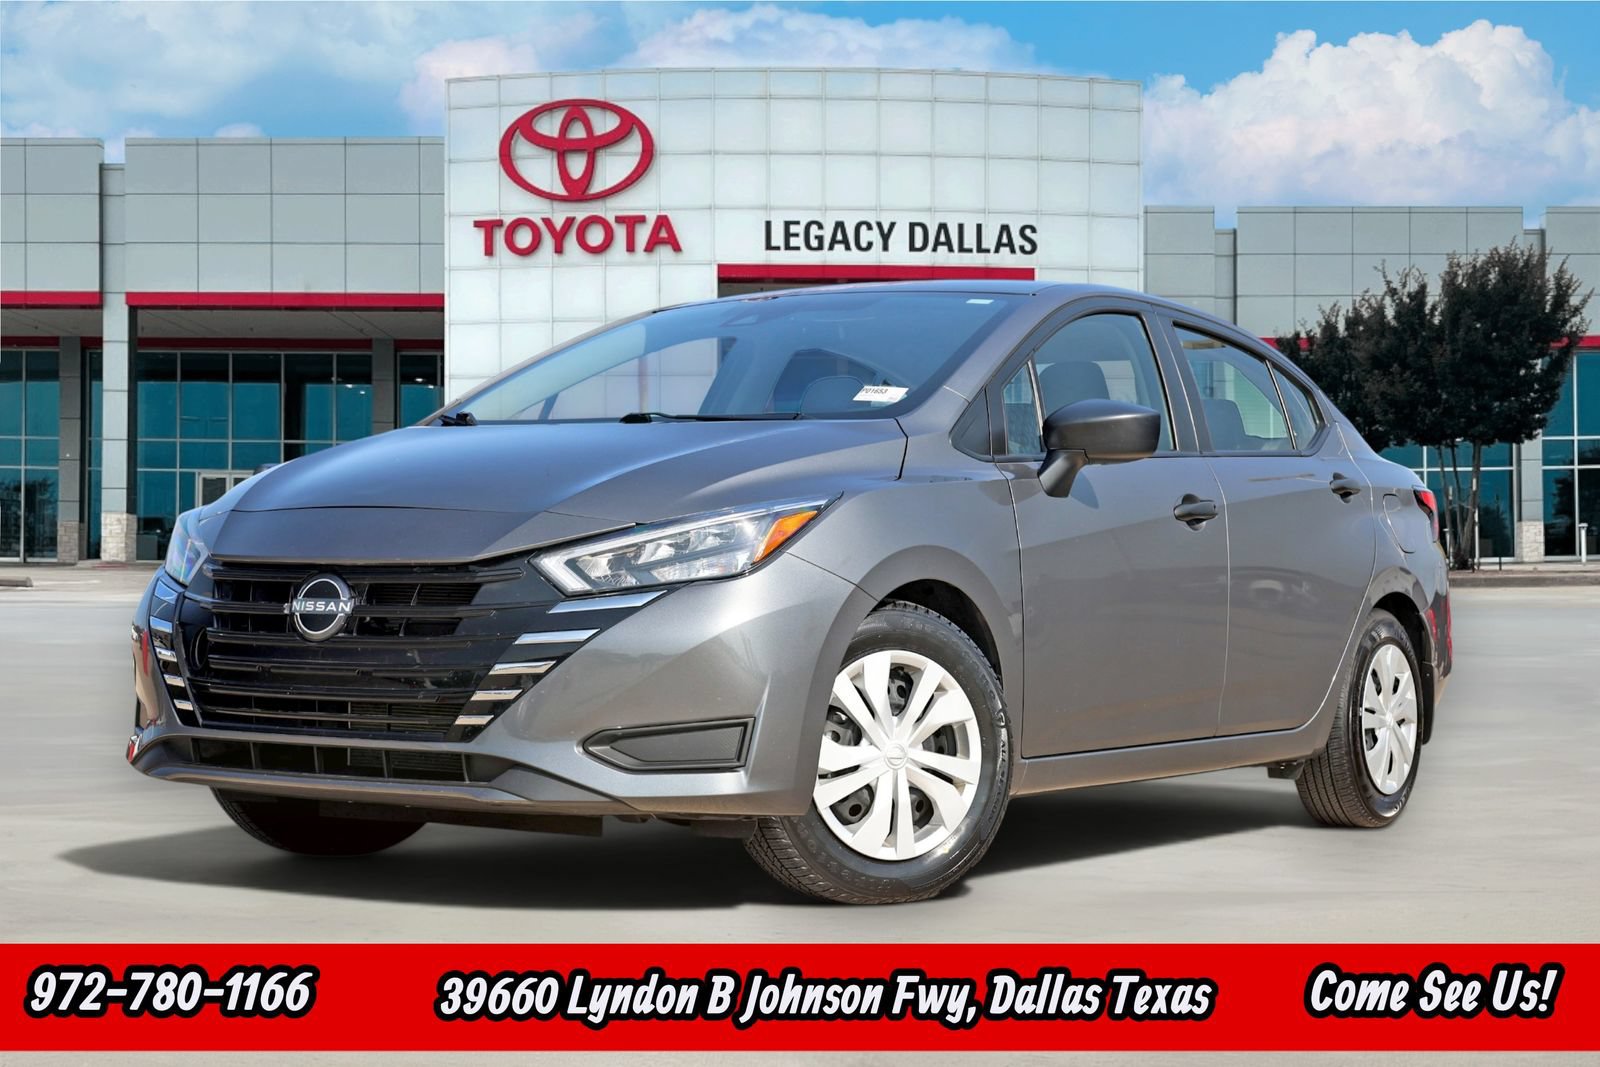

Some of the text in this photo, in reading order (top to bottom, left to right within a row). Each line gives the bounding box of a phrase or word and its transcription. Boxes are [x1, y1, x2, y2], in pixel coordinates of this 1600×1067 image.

[473, 213, 683, 258] TOYOTA
[764, 219, 1038, 255] LEGACY DALLAS
[291, 601, 351, 612] NISSAN
